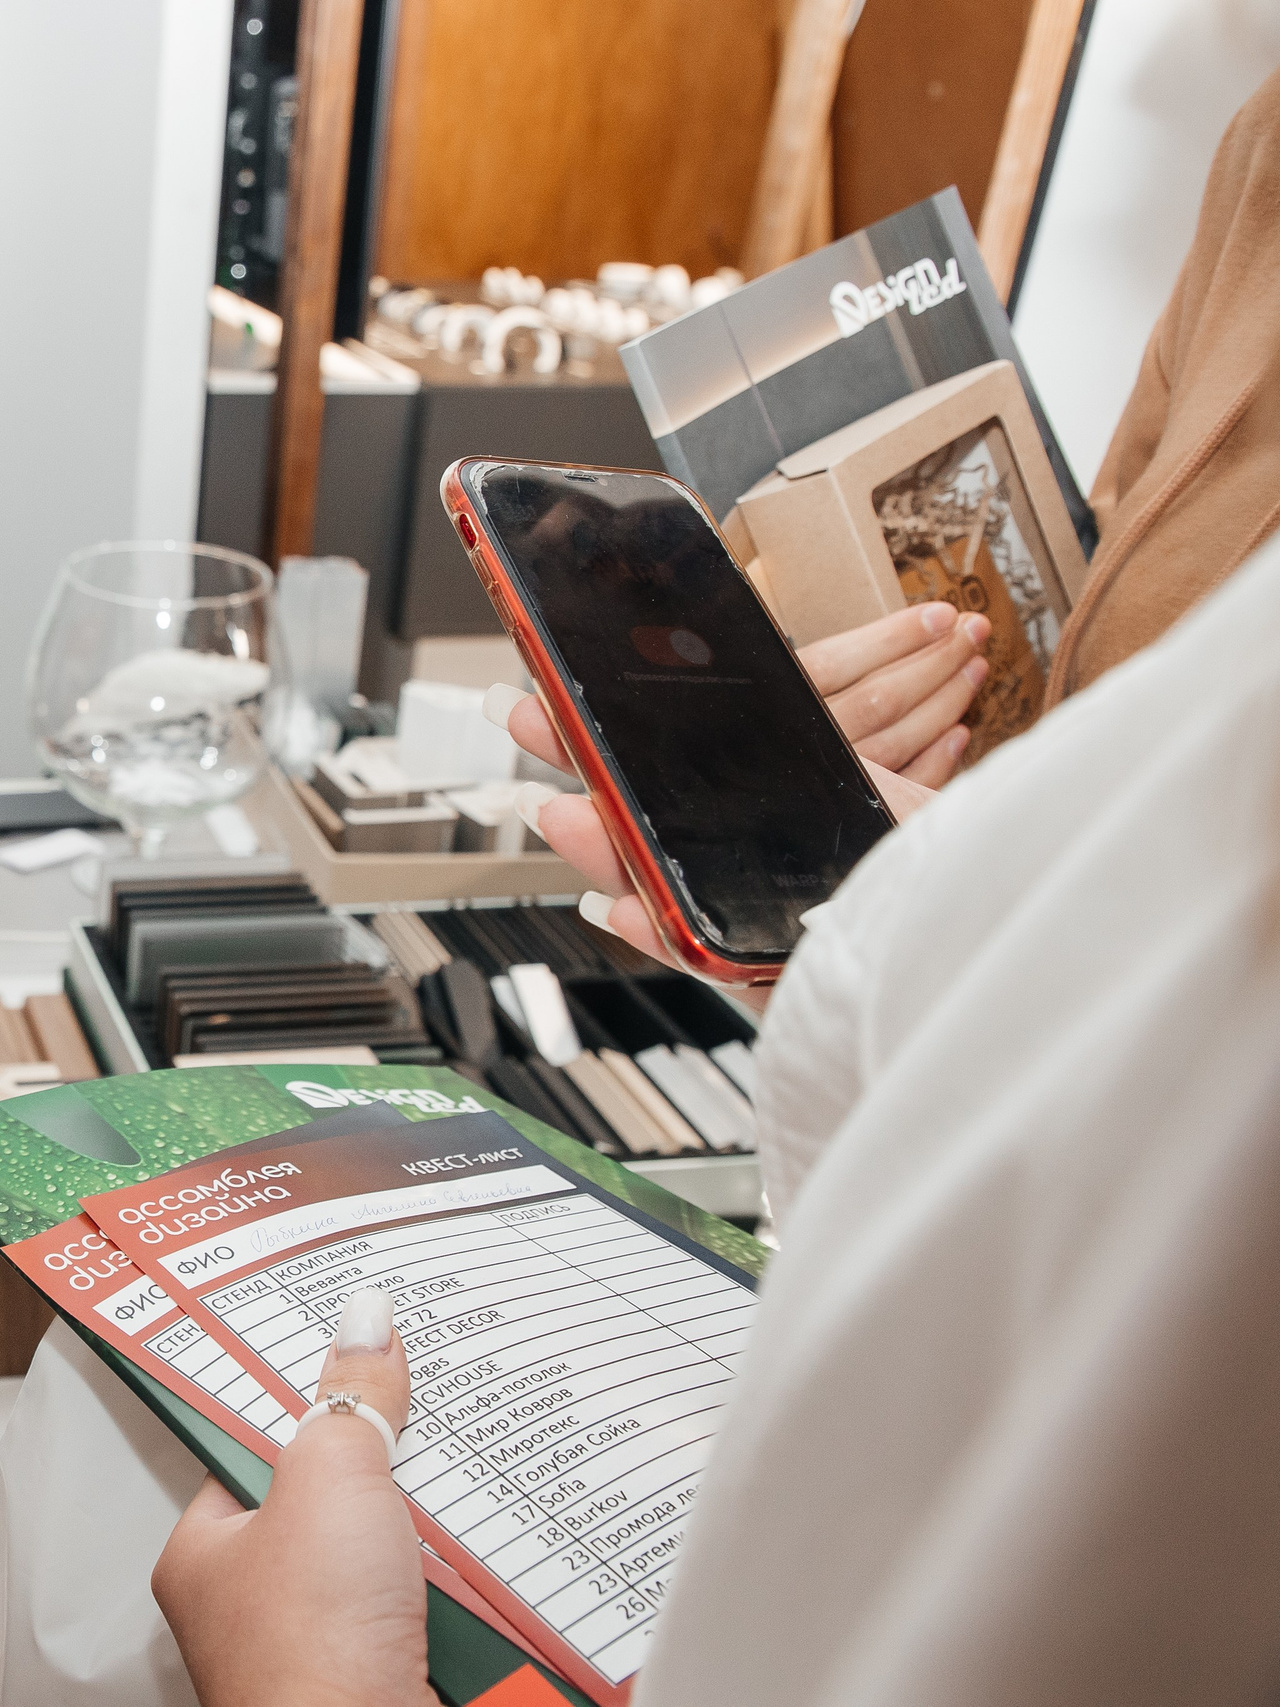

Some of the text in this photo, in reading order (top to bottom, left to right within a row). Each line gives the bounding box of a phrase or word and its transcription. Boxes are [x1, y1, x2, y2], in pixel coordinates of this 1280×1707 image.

[118, 1161, 302, 1225] ассамблея
[138, 1185, 292, 1244] дизайна
[177, 1246, 235, 1275] ФИО
[211, 1202, 570, 1310] СТЕНД КОМПАНИЯ ПОДПИСЬ
[279, 1266, 363, 1305] 1 Веванта
[298, 1310, 314, 1322] 2
[314, 1275, 405, 1314] ПРОкло
[317, 1277, 465, 1339] 3 STORE
[156, 1323, 205, 1354] СТЕН
[411, 1308, 438, 1323] 72
[447, 1310, 505, 1335] DECOR
[410, 1357, 450, 1380] ogas
[421, 1360, 503, 1405] CVHOUSE
[416, 1362, 572, 1442] 10 Альфа-потолок
[438, 1388, 573, 1462] 11 Мир Ковров
[462, 1415, 580, 1483] 12 Миротекс
[487, 1418, 642, 1504] 14 Голубая Сойка
[511, 1479, 587, 1526] 17 Sofia
[537, 1490, 628, 1548] 18 Burkov
[562, 1549, 591, 1571] 23
[590, 1501, 677, 1553] Промода
[588, 1573, 618, 1595] 23
[616, 1596, 646, 1620] 26
